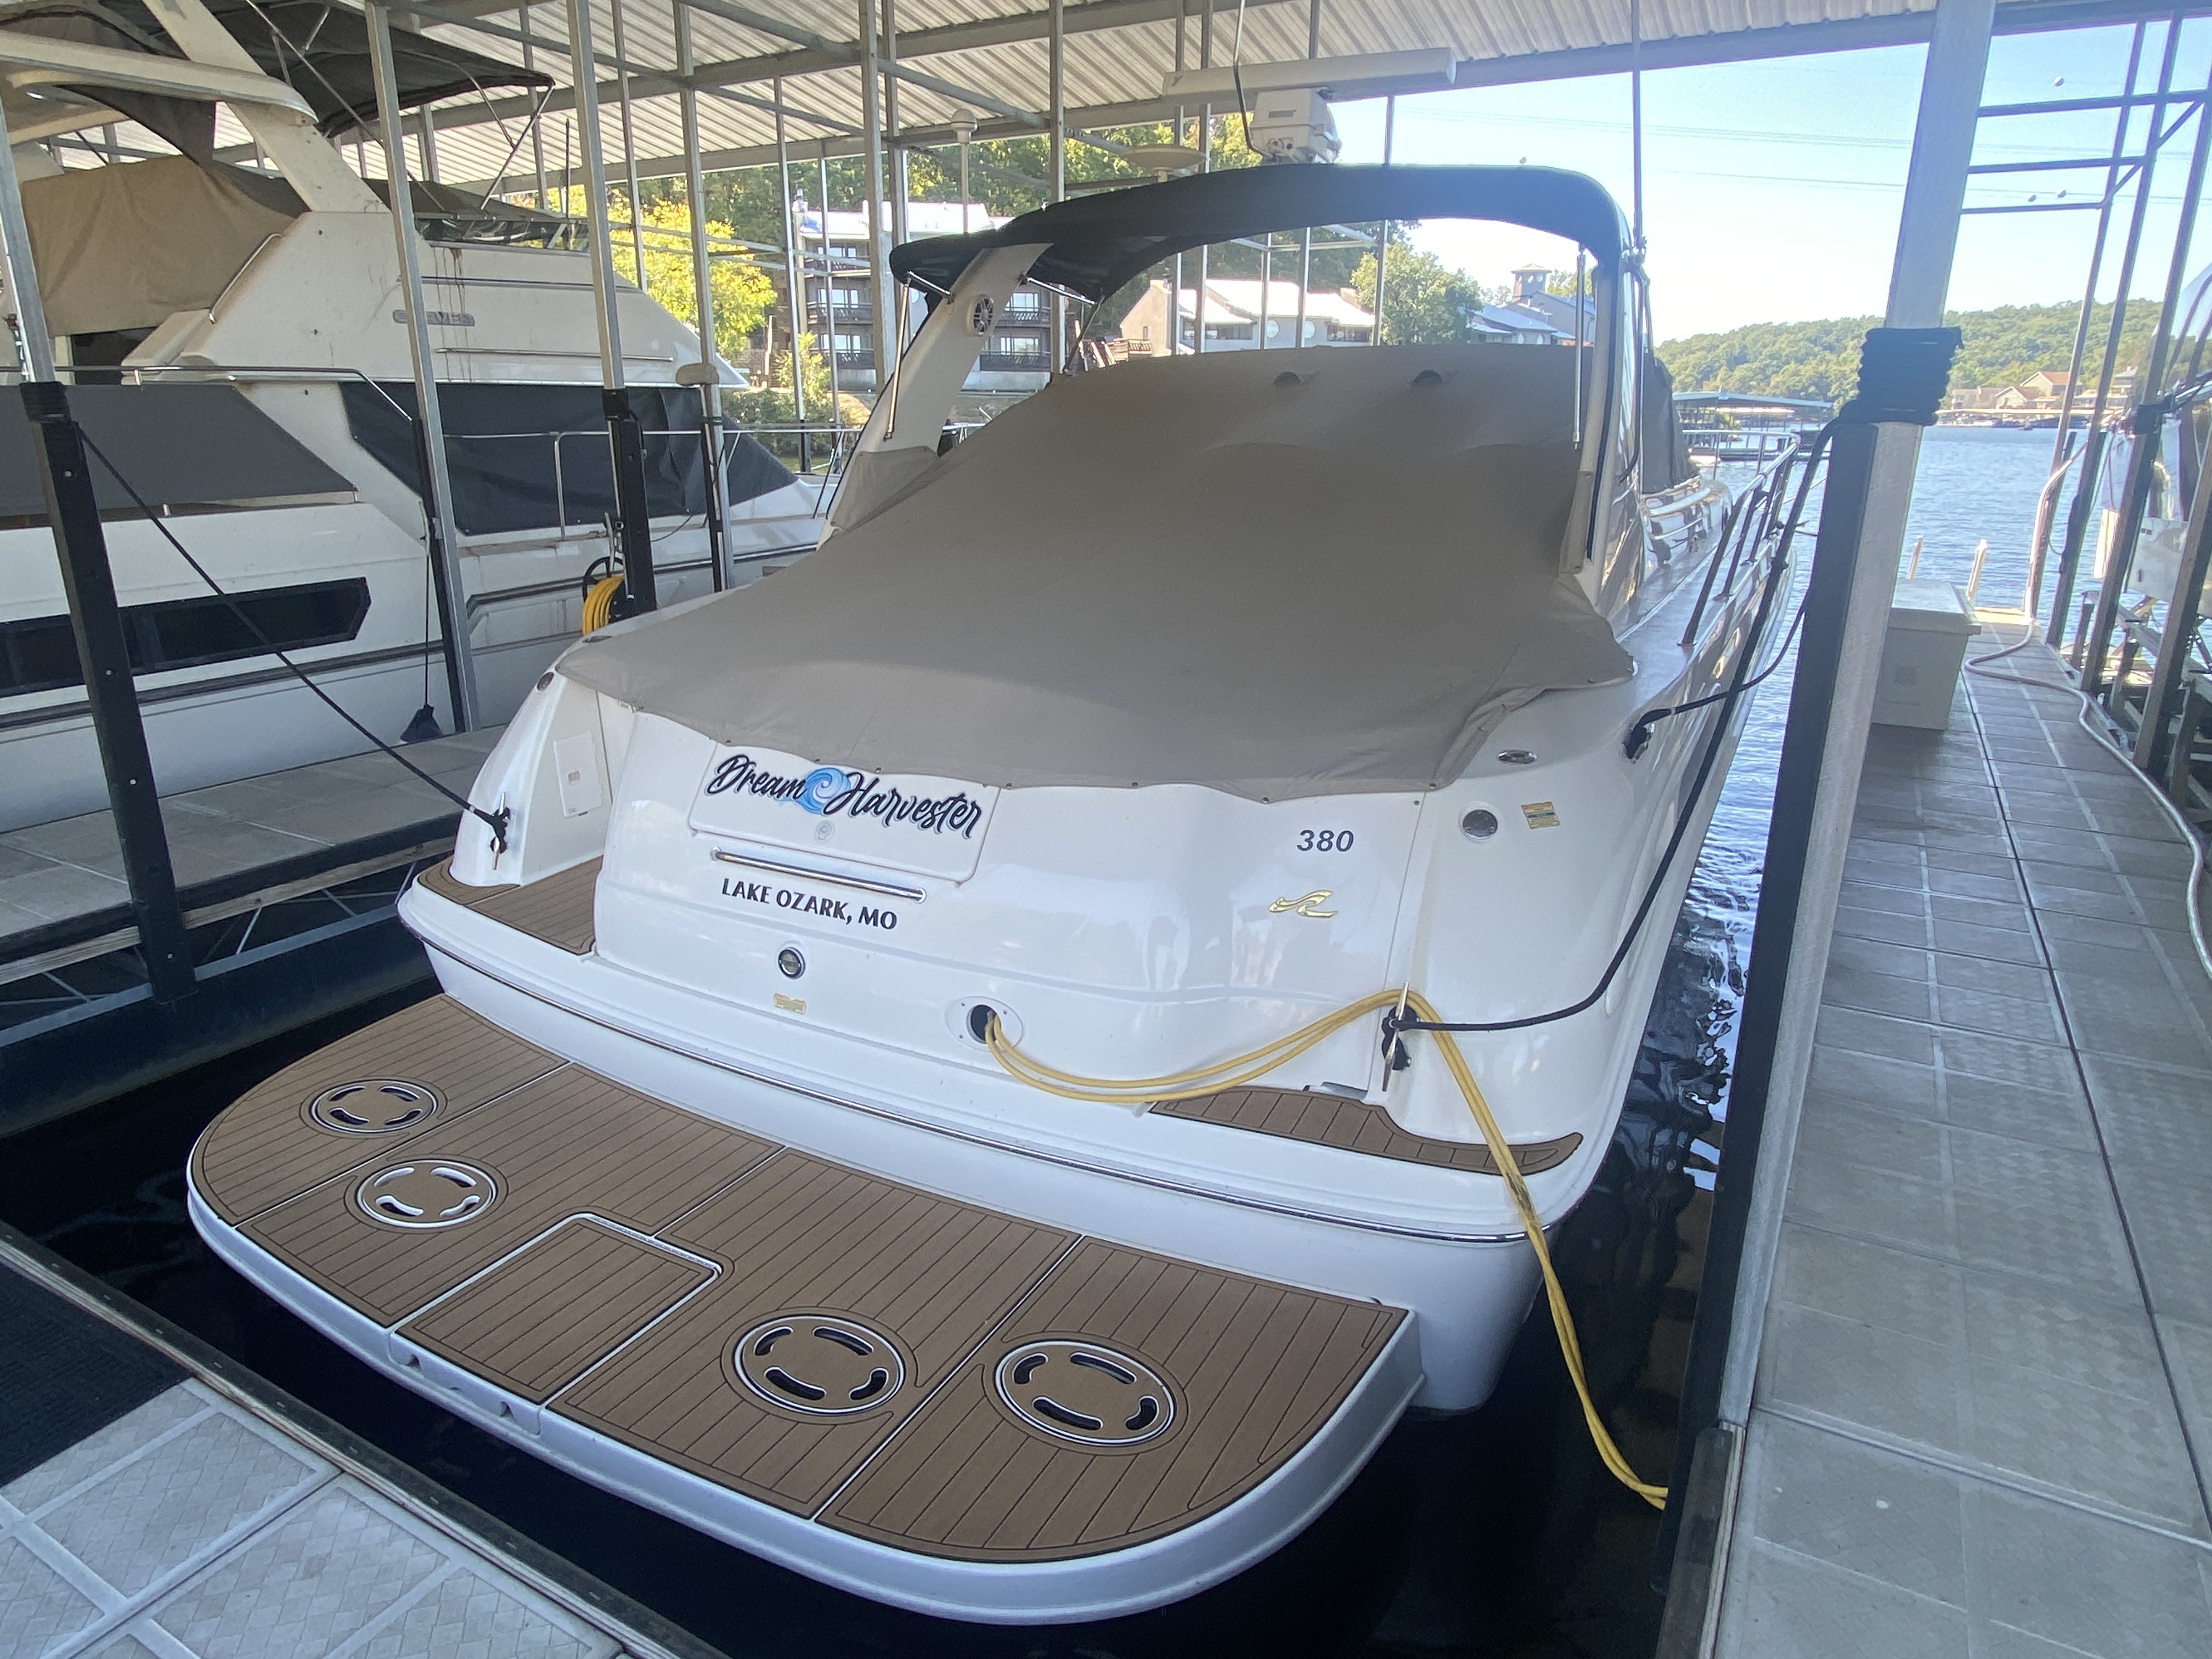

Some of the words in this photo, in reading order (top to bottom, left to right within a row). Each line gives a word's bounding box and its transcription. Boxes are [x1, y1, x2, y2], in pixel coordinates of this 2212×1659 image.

[707, 754, 809, 800] Dream
[823, 772, 983, 838] Harvester
[1296, 830, 1354, 852] 380
[721, 878, 771, 904] LAKE
[776, 889, 853, 925] OZARK,
[858, 906, 898, 929] MO
